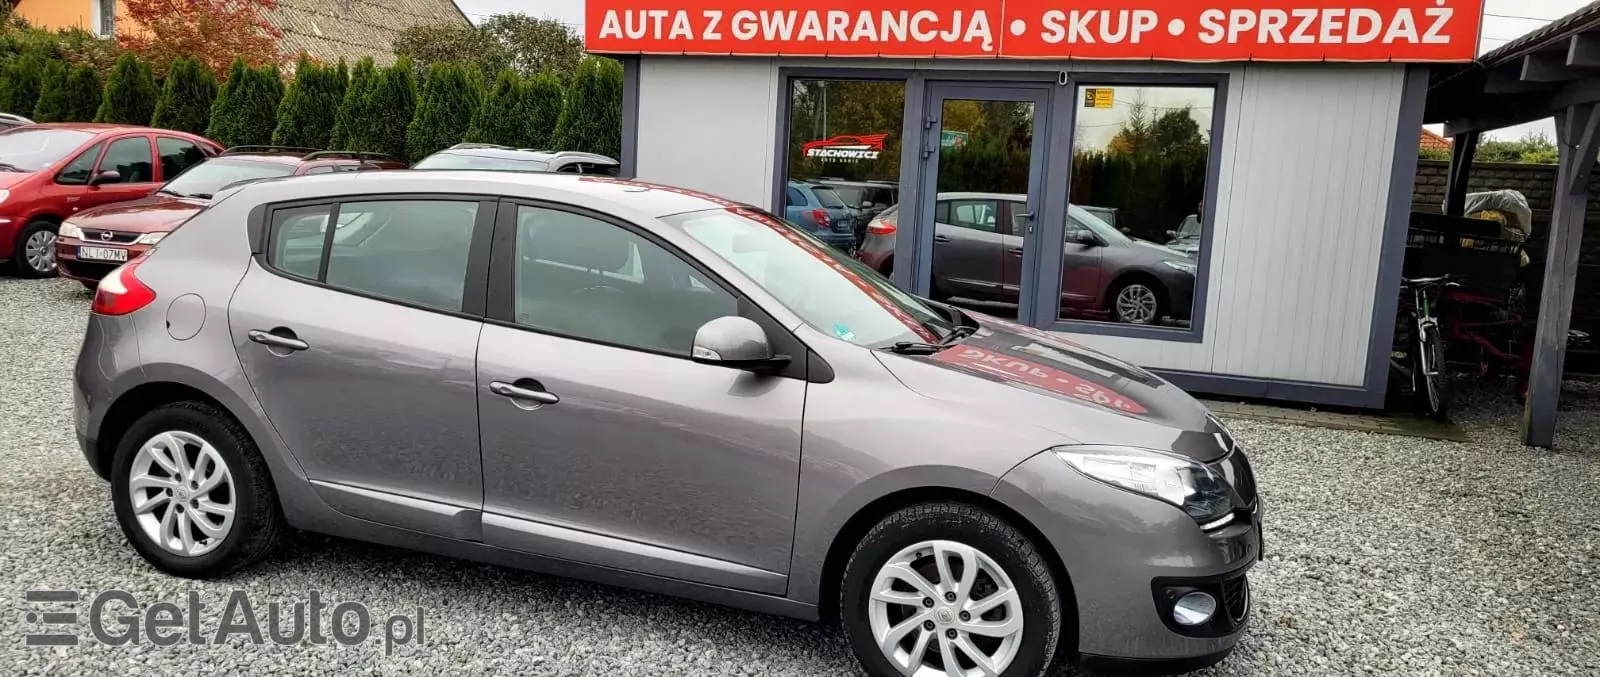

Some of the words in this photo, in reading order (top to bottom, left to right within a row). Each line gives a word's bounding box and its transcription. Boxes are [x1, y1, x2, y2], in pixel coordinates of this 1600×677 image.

[599, 10, 694, 40] AUTA
[702, 10, 723, 40] Z
[731, 10, 993, 52] GWARANCJĄ
[1041, 9, 1158, 44] SKUP
[1198, 0, 1454, 44] SPRZEDAŻ
[806, 148, 880, 159] STACHOWICZ
